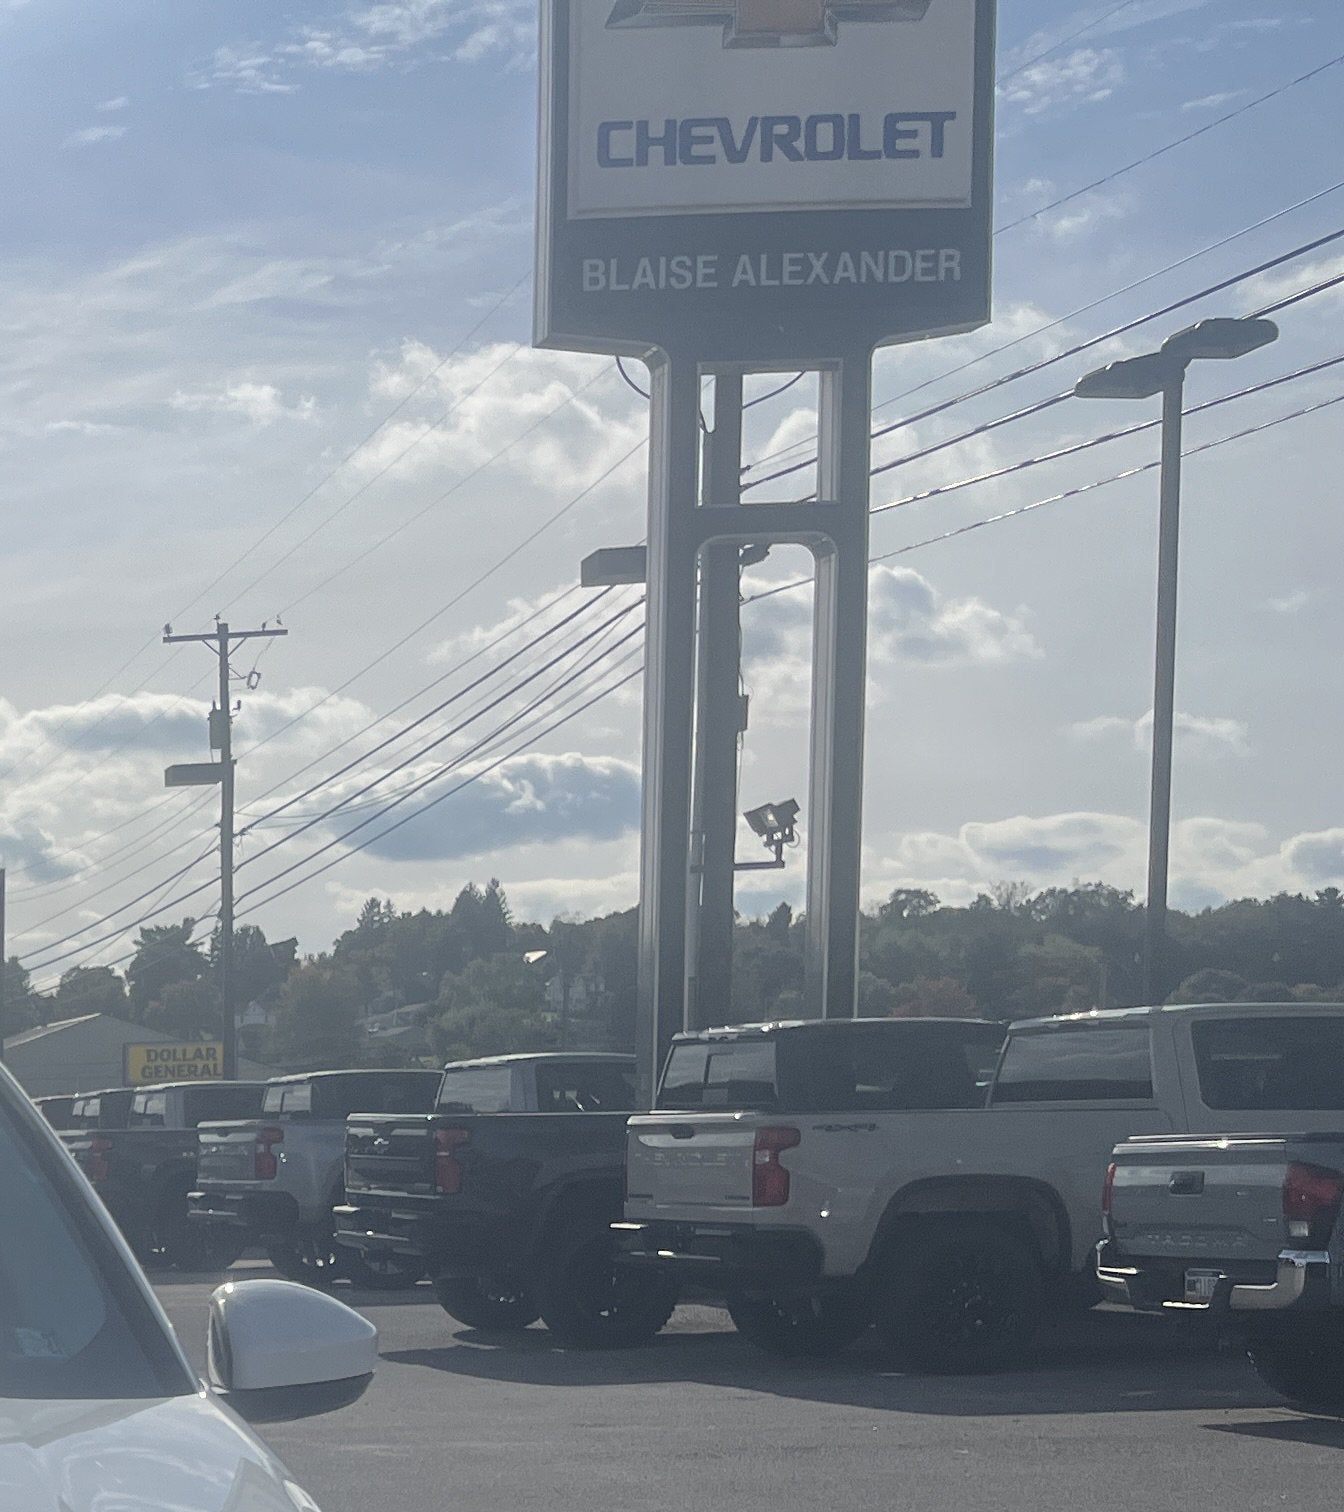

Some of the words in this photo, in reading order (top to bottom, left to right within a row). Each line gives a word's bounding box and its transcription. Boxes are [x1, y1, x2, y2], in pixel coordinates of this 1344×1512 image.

[597, 111, 957, 168] CHEVROLET
[582, 255, 719, 291] BLAISE
[731, 248, 963, 287] ALEXANDER
[146, 1047, 217, 1062] DOLLAR
[141, 1063, 223, 1079] GENERAL
